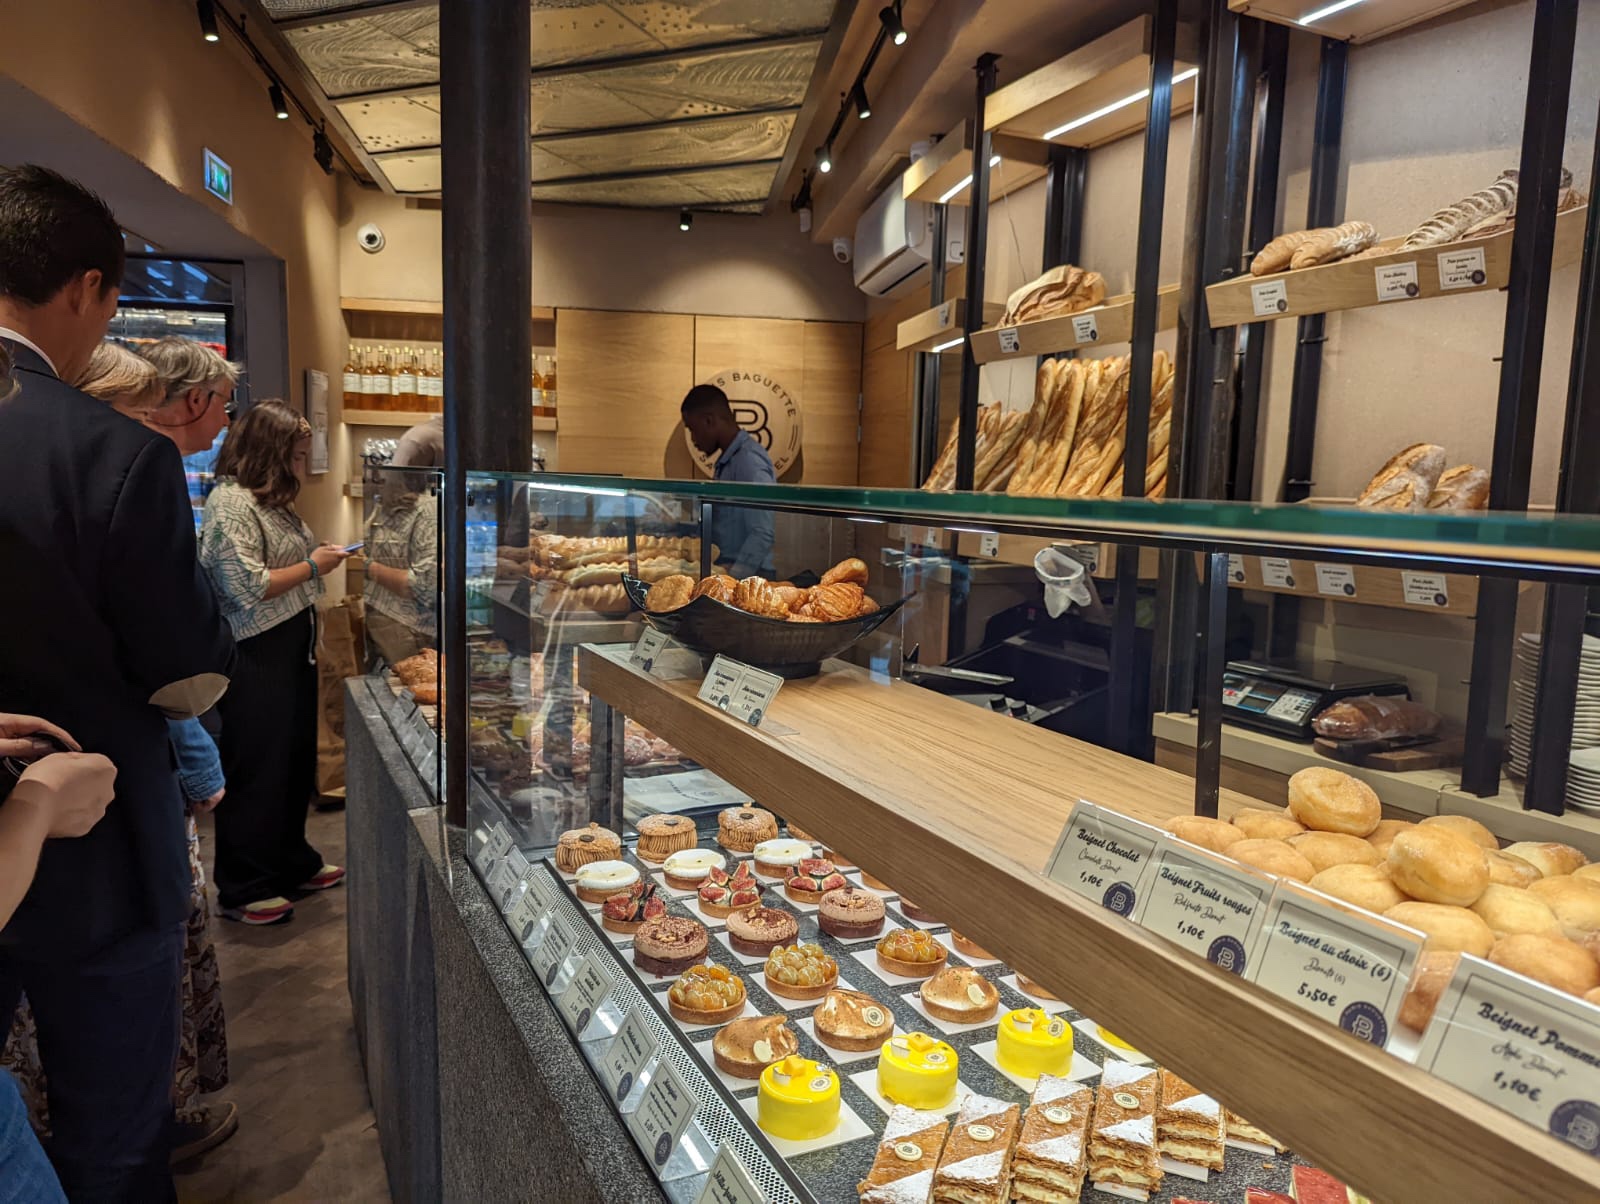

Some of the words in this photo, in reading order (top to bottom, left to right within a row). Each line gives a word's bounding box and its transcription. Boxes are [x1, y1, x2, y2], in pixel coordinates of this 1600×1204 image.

[732, 373, 796, 416] BAGUETTE
[1077, 828, 1105, 849] Beignet
[1105, 840, 1140, 863] Chocolat
[1080, 871, 1103, 887] 1,10€
[1160, 867, 1192, 890] Beignet
[1191, 879, 1221, 902] Fruits
[1222, 896, 1252, 917] rouges
[1177, 920, 1205, 940] 1,10€
[1279, 921, 1320, 948] Beignet
[1321, 942, 1336, 956] au
[1336, 948, 1368, 970] choix
[1371, 962, 1392, 982] (6)
[1297, 982, 1337, 1007] 5,50€
[1477, 1001, 1539, 1039] Beignet
[1493, 1071, 1542, 1102] 1,10€
